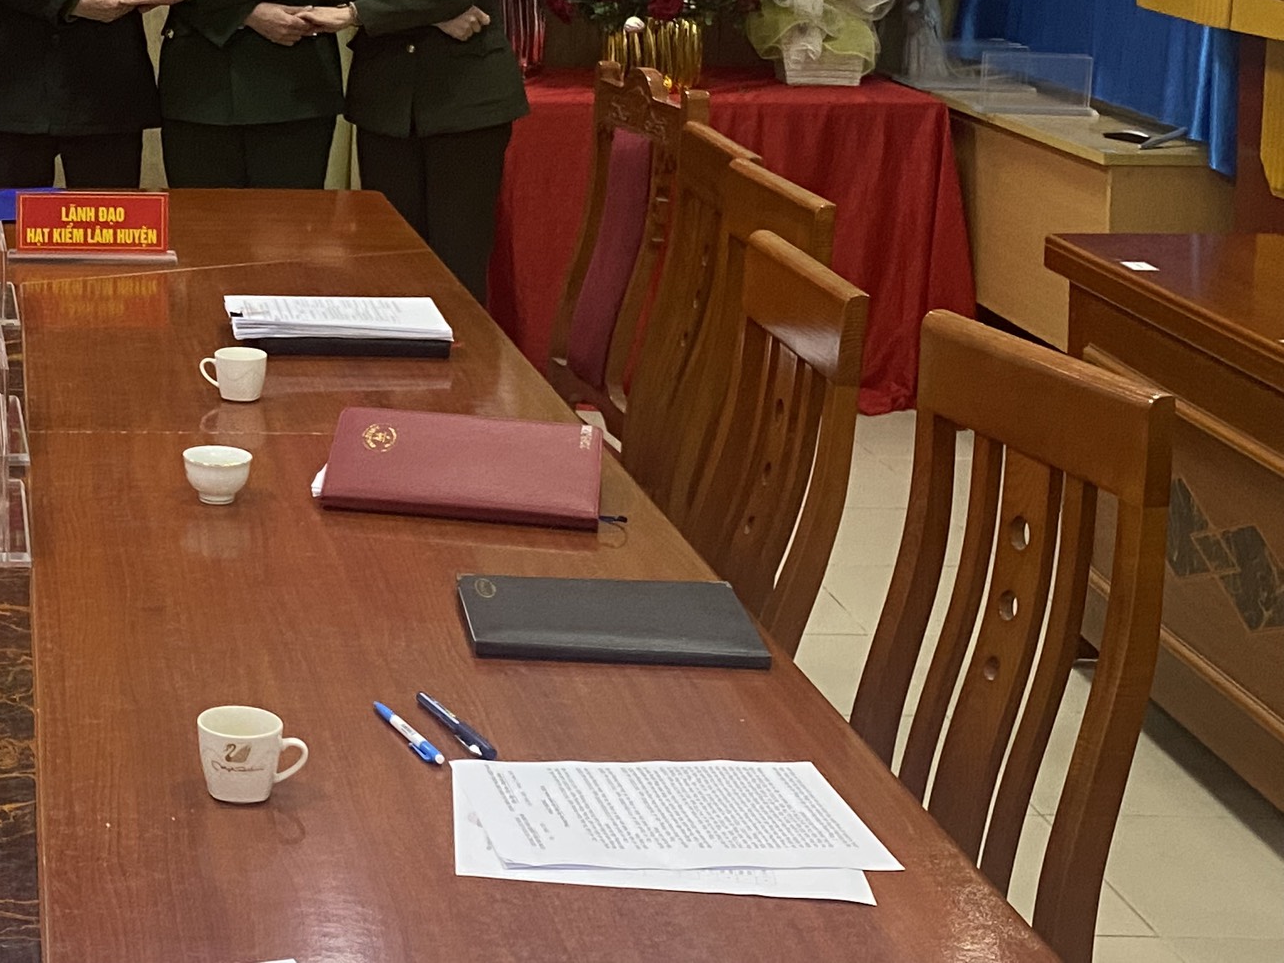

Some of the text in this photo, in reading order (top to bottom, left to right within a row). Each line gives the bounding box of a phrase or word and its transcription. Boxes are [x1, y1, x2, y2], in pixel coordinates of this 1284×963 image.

[61, 204, 125, 225] LÃNH ĐẠO
[26, 223, 157, 247] HẠT KIỂM LÂM HUYỆN
